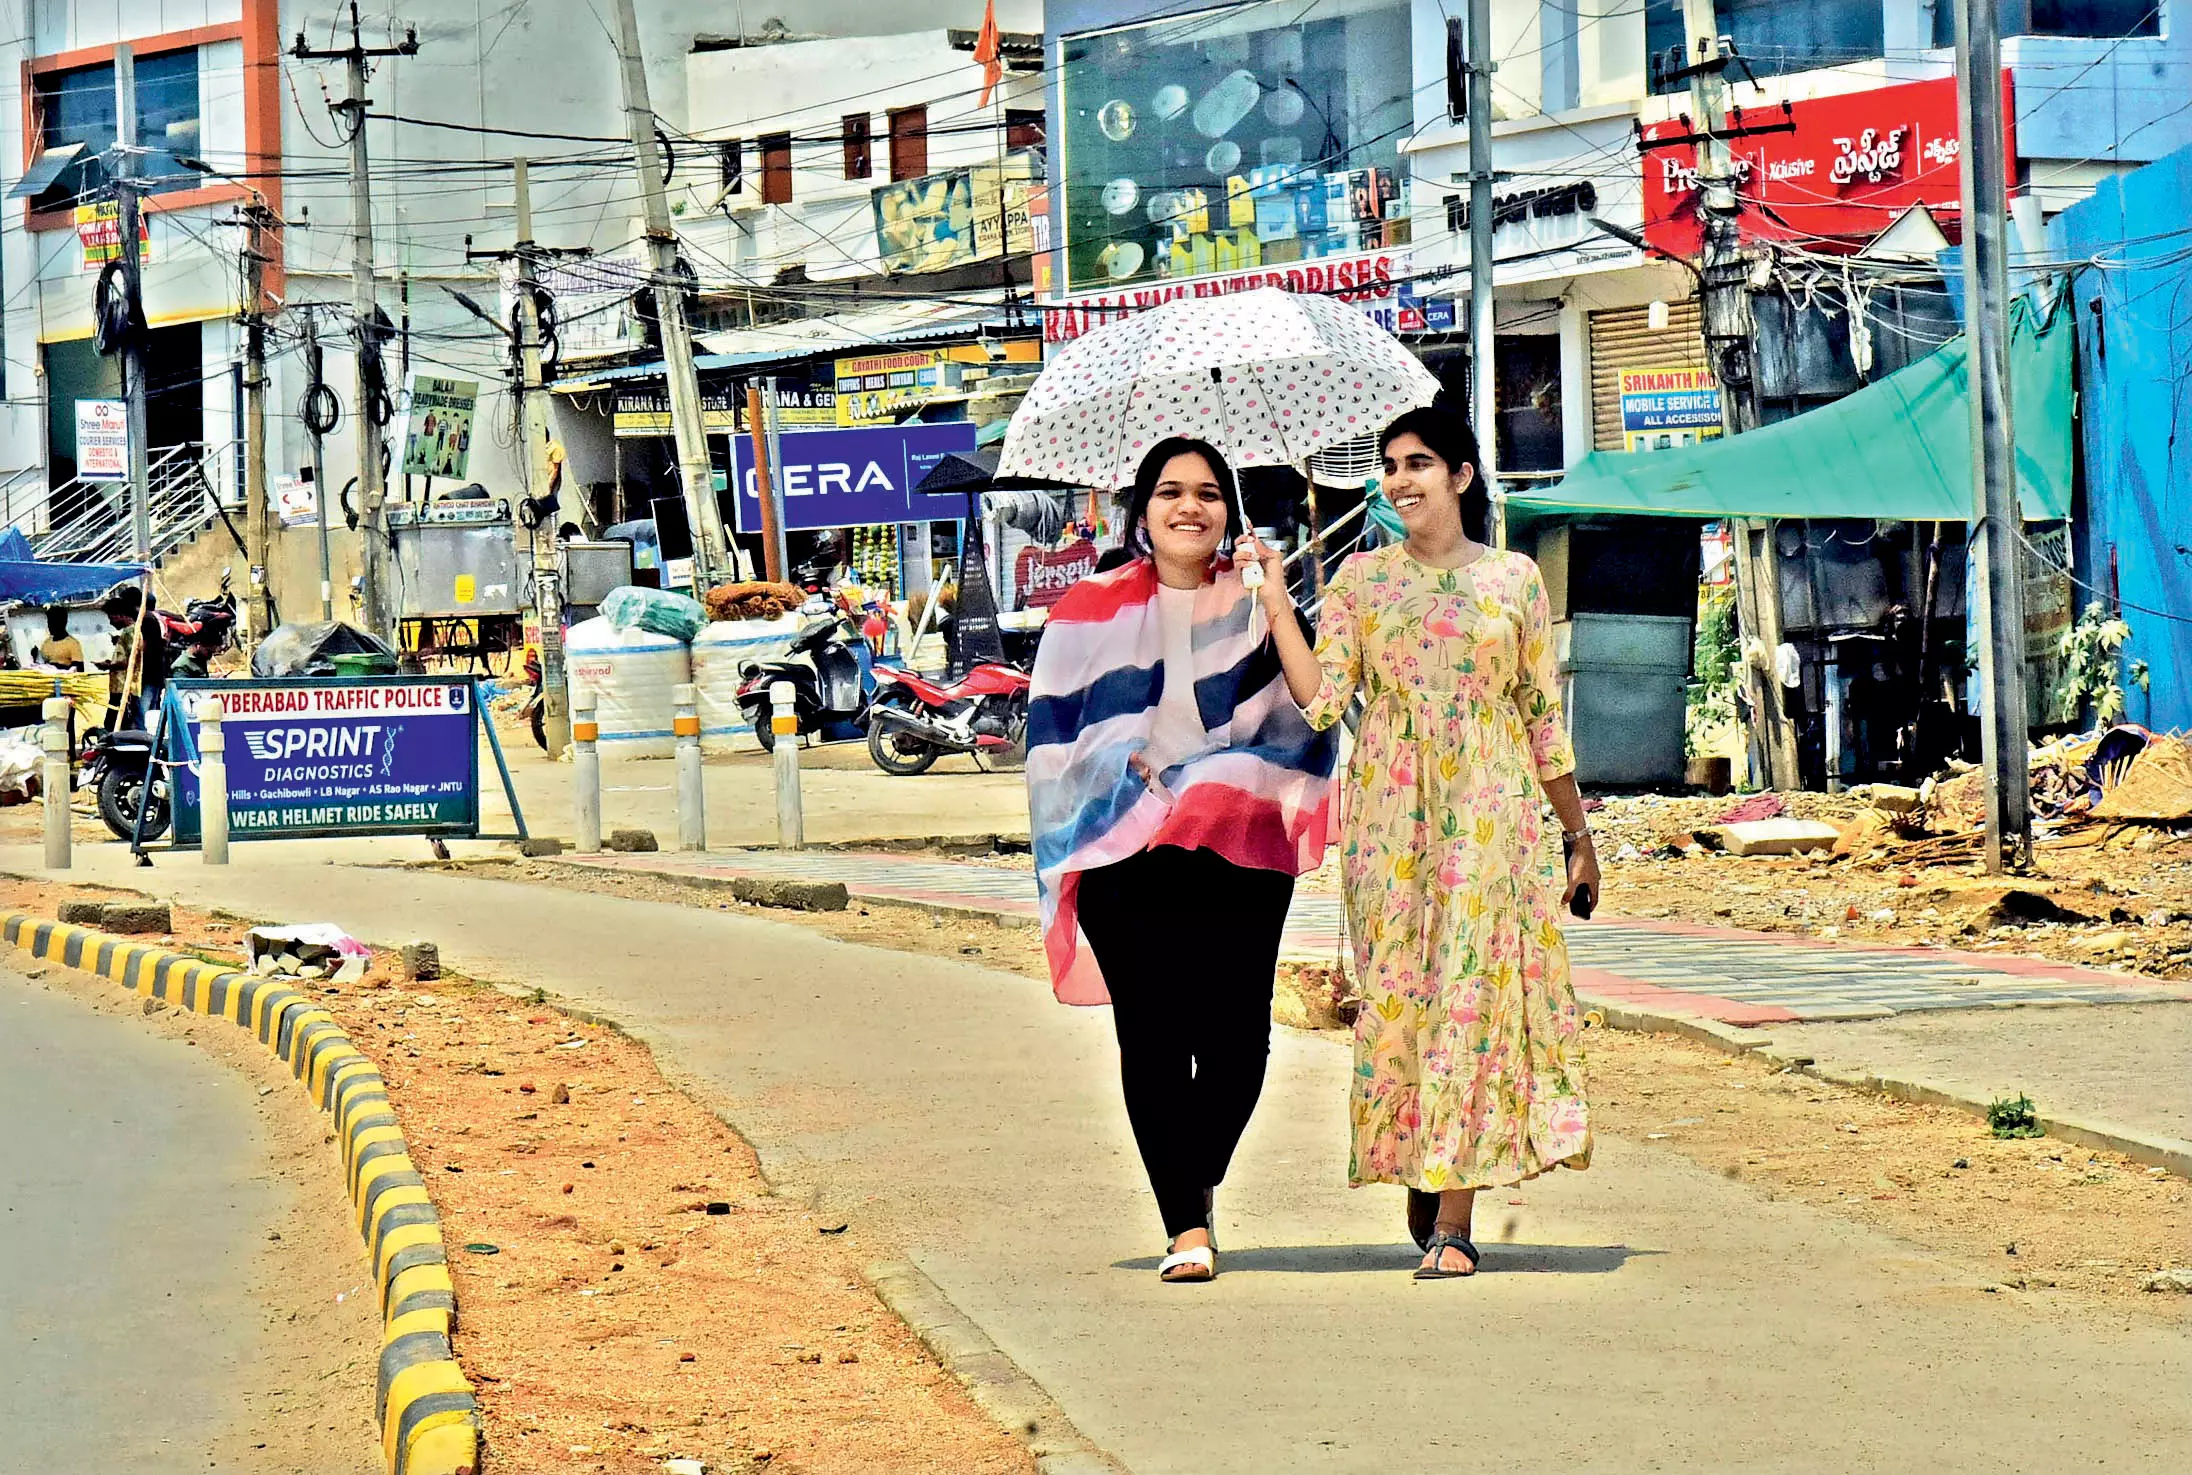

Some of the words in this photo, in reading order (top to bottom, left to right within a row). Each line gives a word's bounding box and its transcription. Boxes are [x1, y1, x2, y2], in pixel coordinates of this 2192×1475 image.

[1662, 147, 1749, 194] Pree
[1442, 180, 1598, 234] Tuperware
[980, 210, 1029, 234] AYYPPA
[1427, 310, 1449, 322] CERA
[883, 356, 903, 369] FOOD
[904, 353, 930, 367] COURT
[864, 375, 886, 391] MEALS
[1623, 372, 1692, 393] SRIKANTH
[617, 396, 653, 412] KIRANA
[655, 399, 662, 411] &
[702, 396, 728, 410] STORE
[803, 393, 812, 407] &
[1625, 397, 1665, 414] MOBILE
[1667, 394, 1711, 412] SERVICE
[80, 418, 101, 431] Shree
[1643, 413, 1664, 427] ALL
[80, 435, 101, 446] COURIER
[210, 690, 310, 715] YBERABAD
[313, 688, 380, 712] TRAFFIC
[384, 686, 442, 709] POLICE
[245, 725, 382, 760] SPRINT
[263, 763, 374, 782] DIAGNOSTICS
[231, 789, 252, 801] Hills
[259, 786, 312, 799] Gachibowli
[319, 785, 333, 797] LB
[334, 785, 360, 799] Nagar
[368, 783, 382, 795] AS
[384, 783, 401, 794] Rao
[402, 782, 429, 796] Nagar
[437, 780, 463, 792] JNTU
[231, 809, 279, 828] WEAR
[281, 806, 344, 826] HELMET
[346, 804, 381, 823] RIDE
[384, 802, 439, 821] SAFELY
